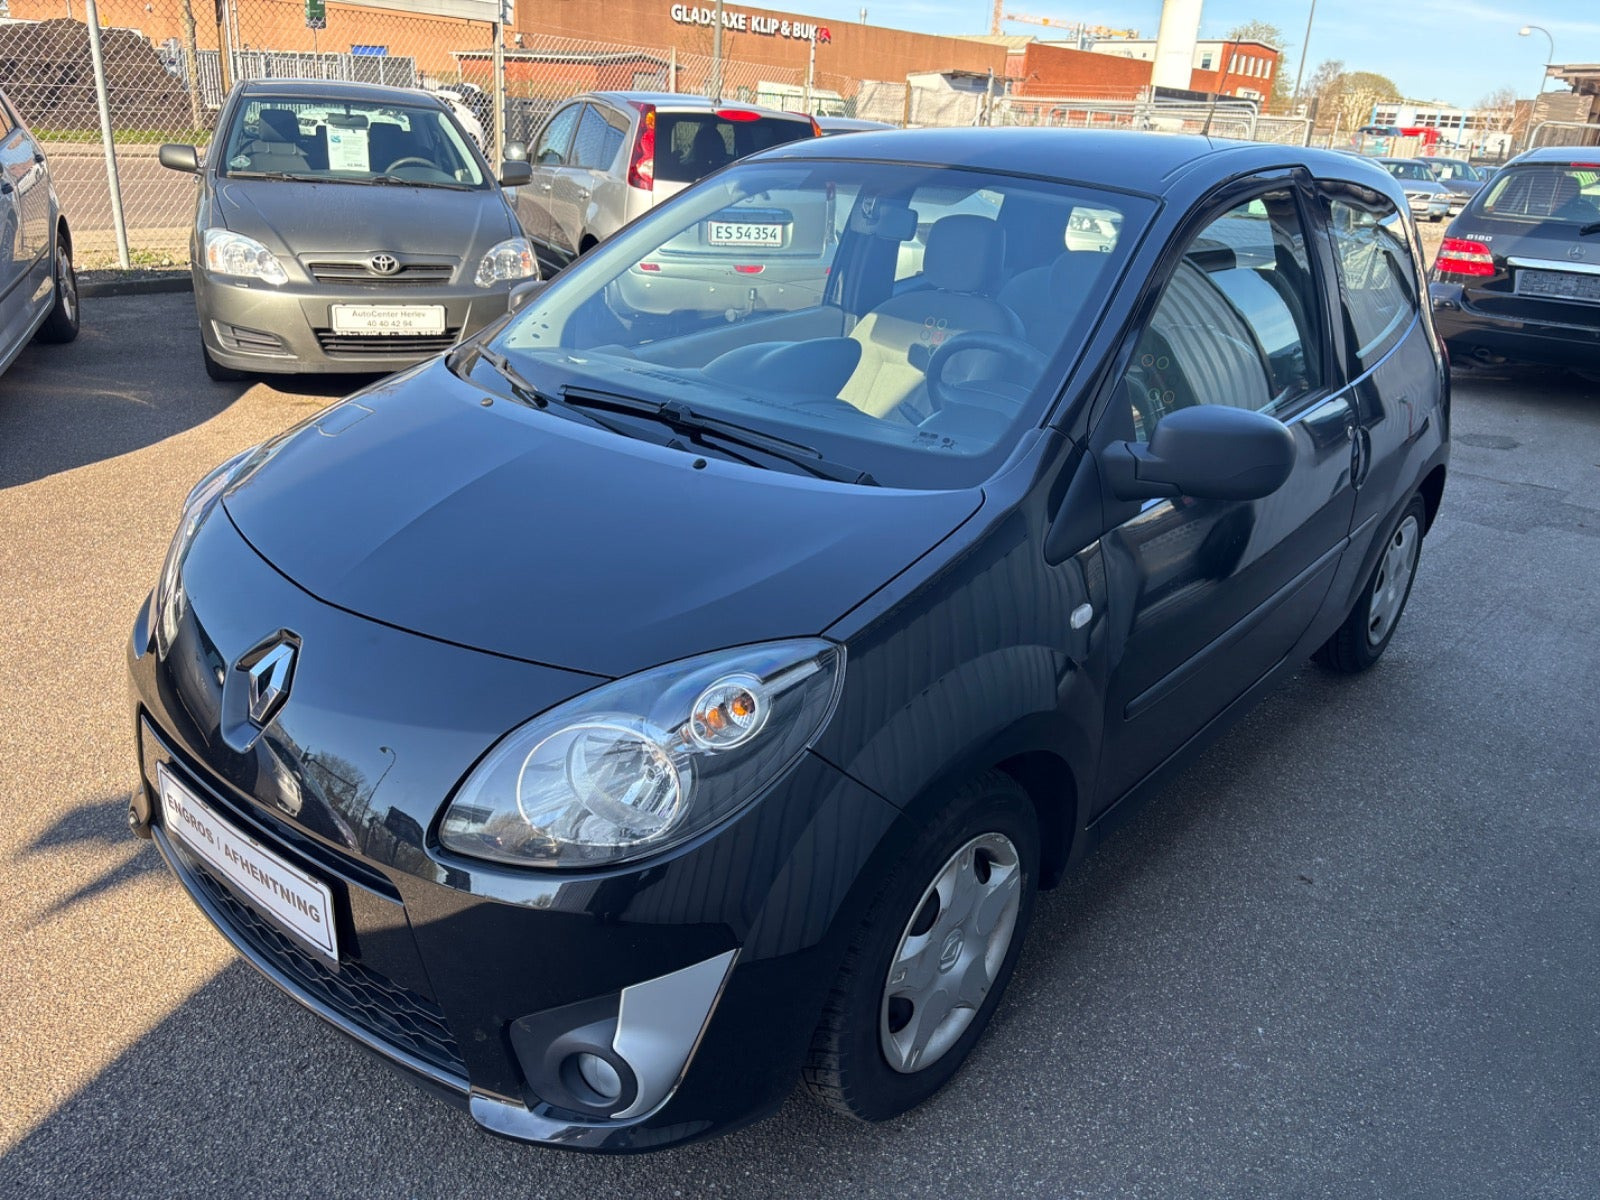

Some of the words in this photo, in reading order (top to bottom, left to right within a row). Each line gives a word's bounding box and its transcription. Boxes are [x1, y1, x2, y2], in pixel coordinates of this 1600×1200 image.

[671, 4, 746, 30] GLADSAXE
[751, 16, 780, 34] KLIP
[781, 20, 791, 36] &
[716, 226, 733, 239] ES
[736, 226, 751, 240] 54
[754, 227, 777, 240] 354
[401, 310, 426, 318] Herlev
[166, 793, 214, 845] ENGROS
[224, 844, 321, 923] AFHENTNING
